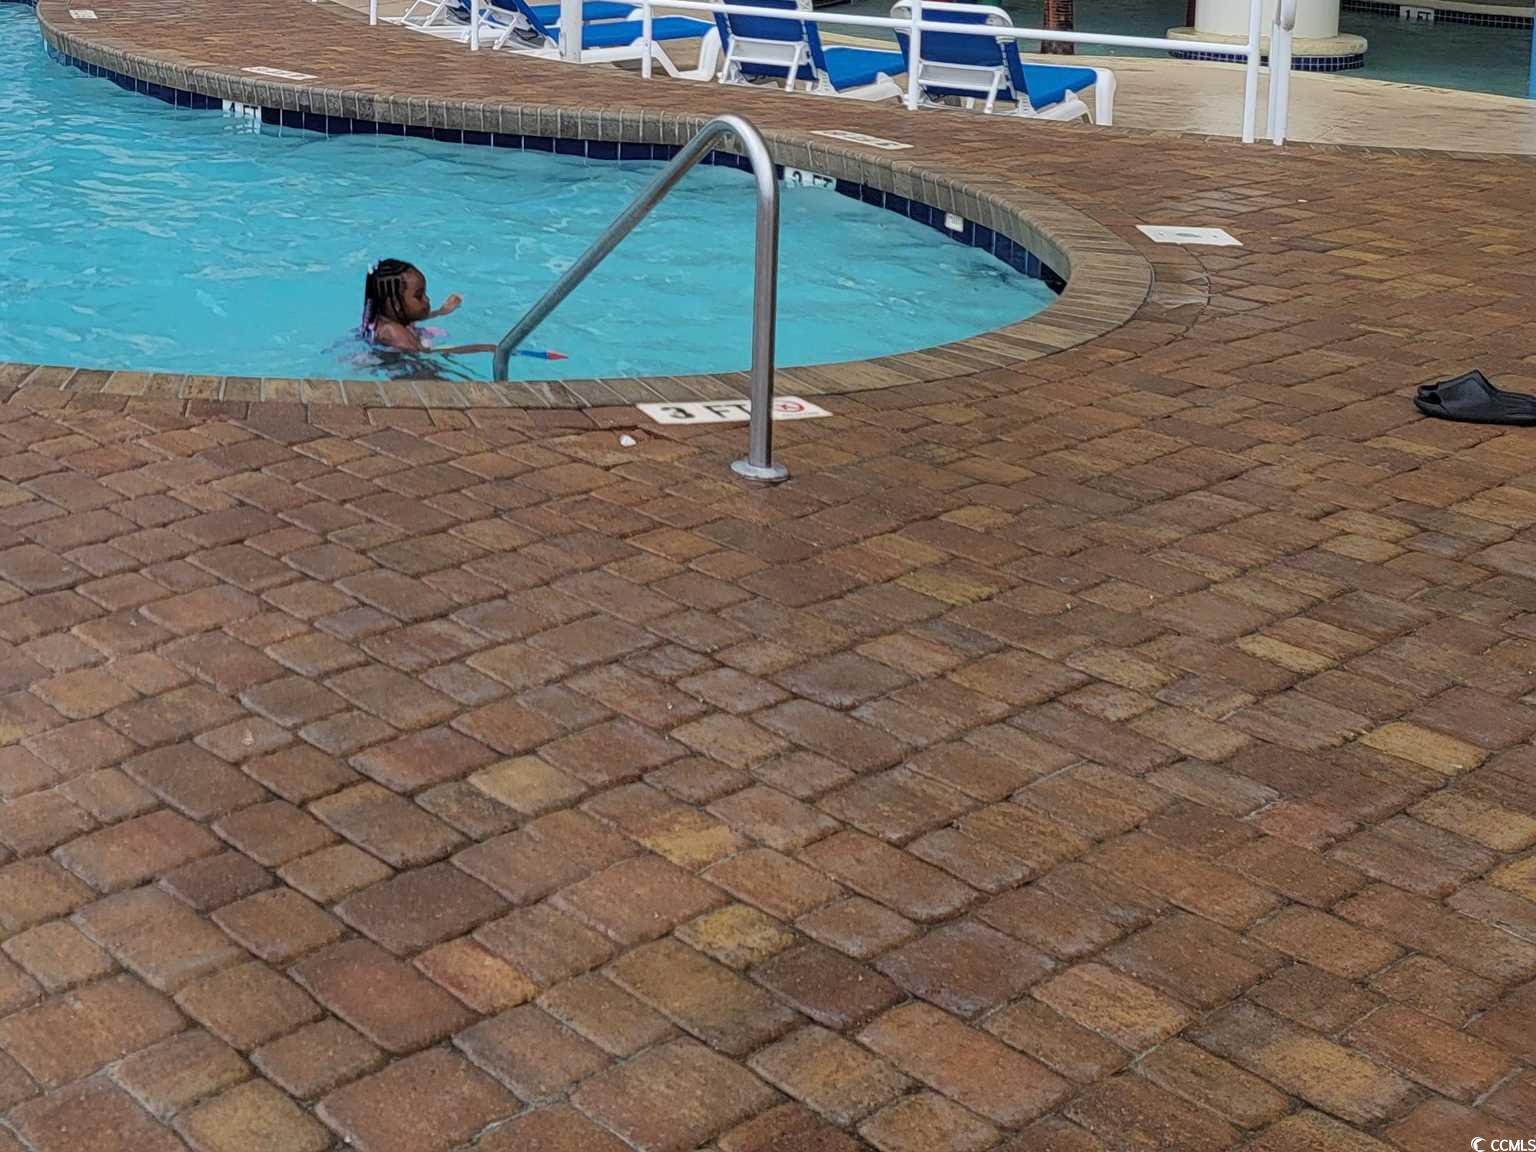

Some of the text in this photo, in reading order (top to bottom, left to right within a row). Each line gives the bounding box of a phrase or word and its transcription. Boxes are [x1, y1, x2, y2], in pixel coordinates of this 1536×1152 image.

[1406, 9, 1432, 21] 1 FT
[660, 403, 752, 419] 3 FT
